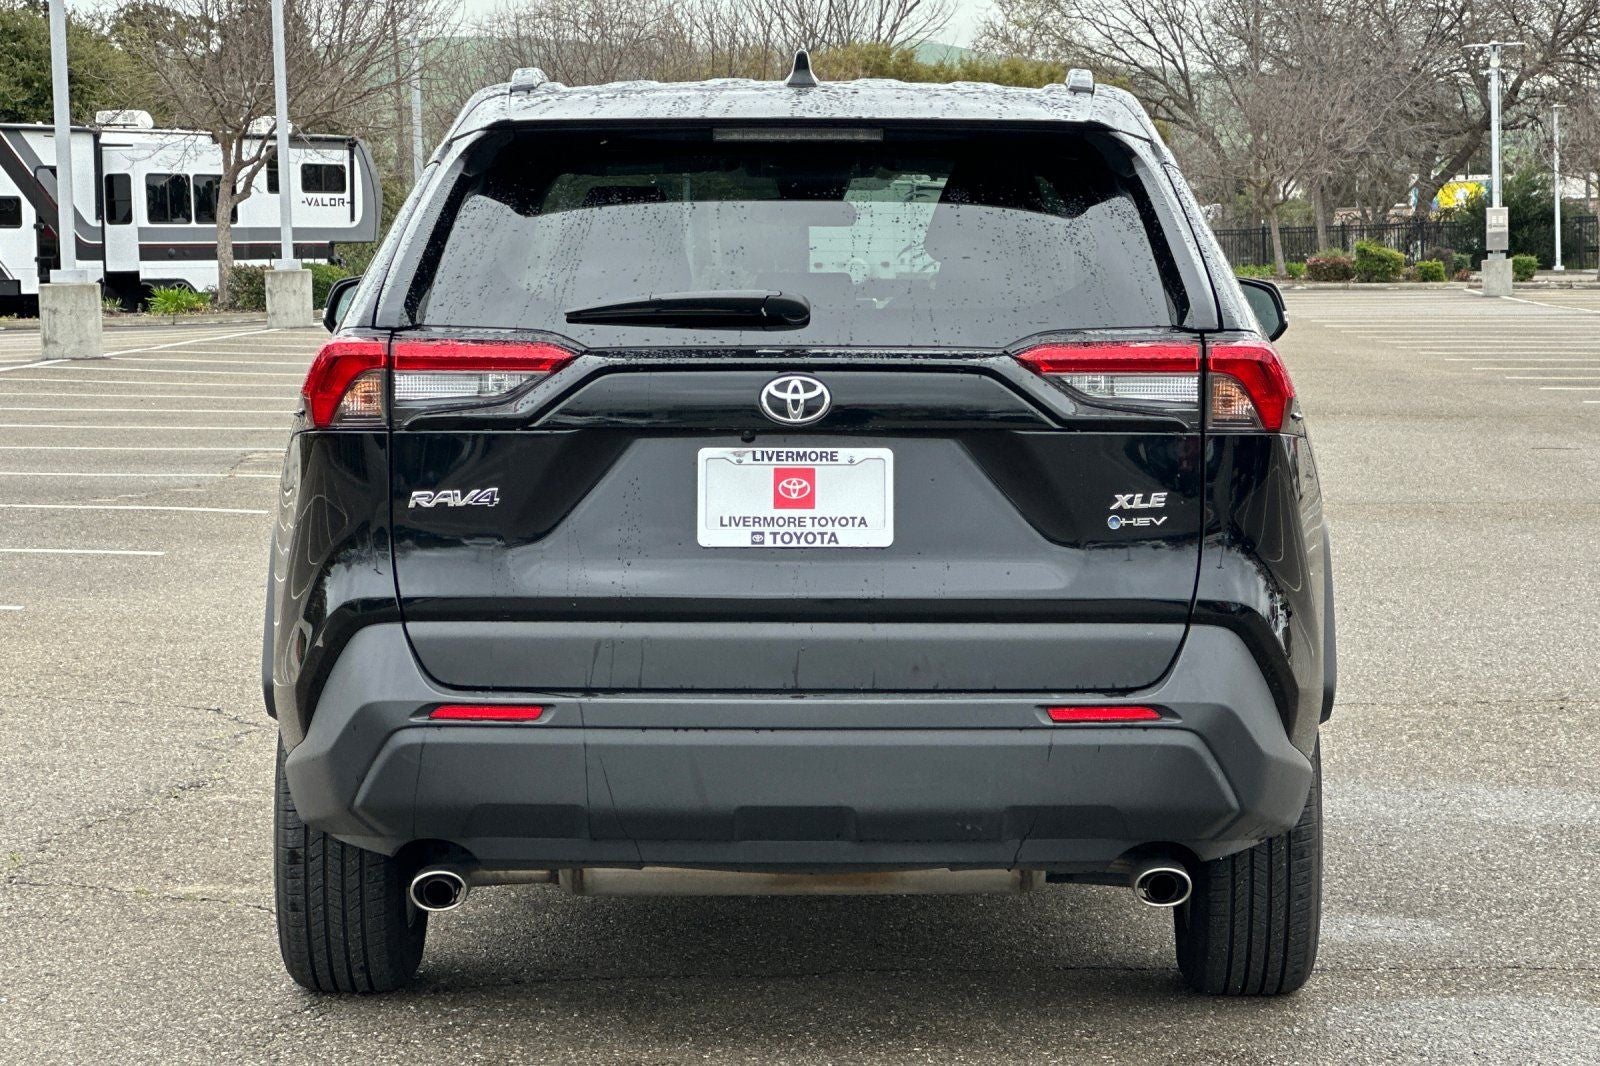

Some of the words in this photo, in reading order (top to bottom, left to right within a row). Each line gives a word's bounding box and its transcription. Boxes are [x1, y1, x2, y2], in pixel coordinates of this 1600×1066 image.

[752, 450, 839, 462] LIVERMORE
[408, 487, 500, 508] RAV4
[1109, 492, 1168, 509] XLE
[719, 516, 806, 528] LIVERMORE
[809, 516, 868, 528] TOYOTA
[769, 531, 839, 545] TOYOTA
